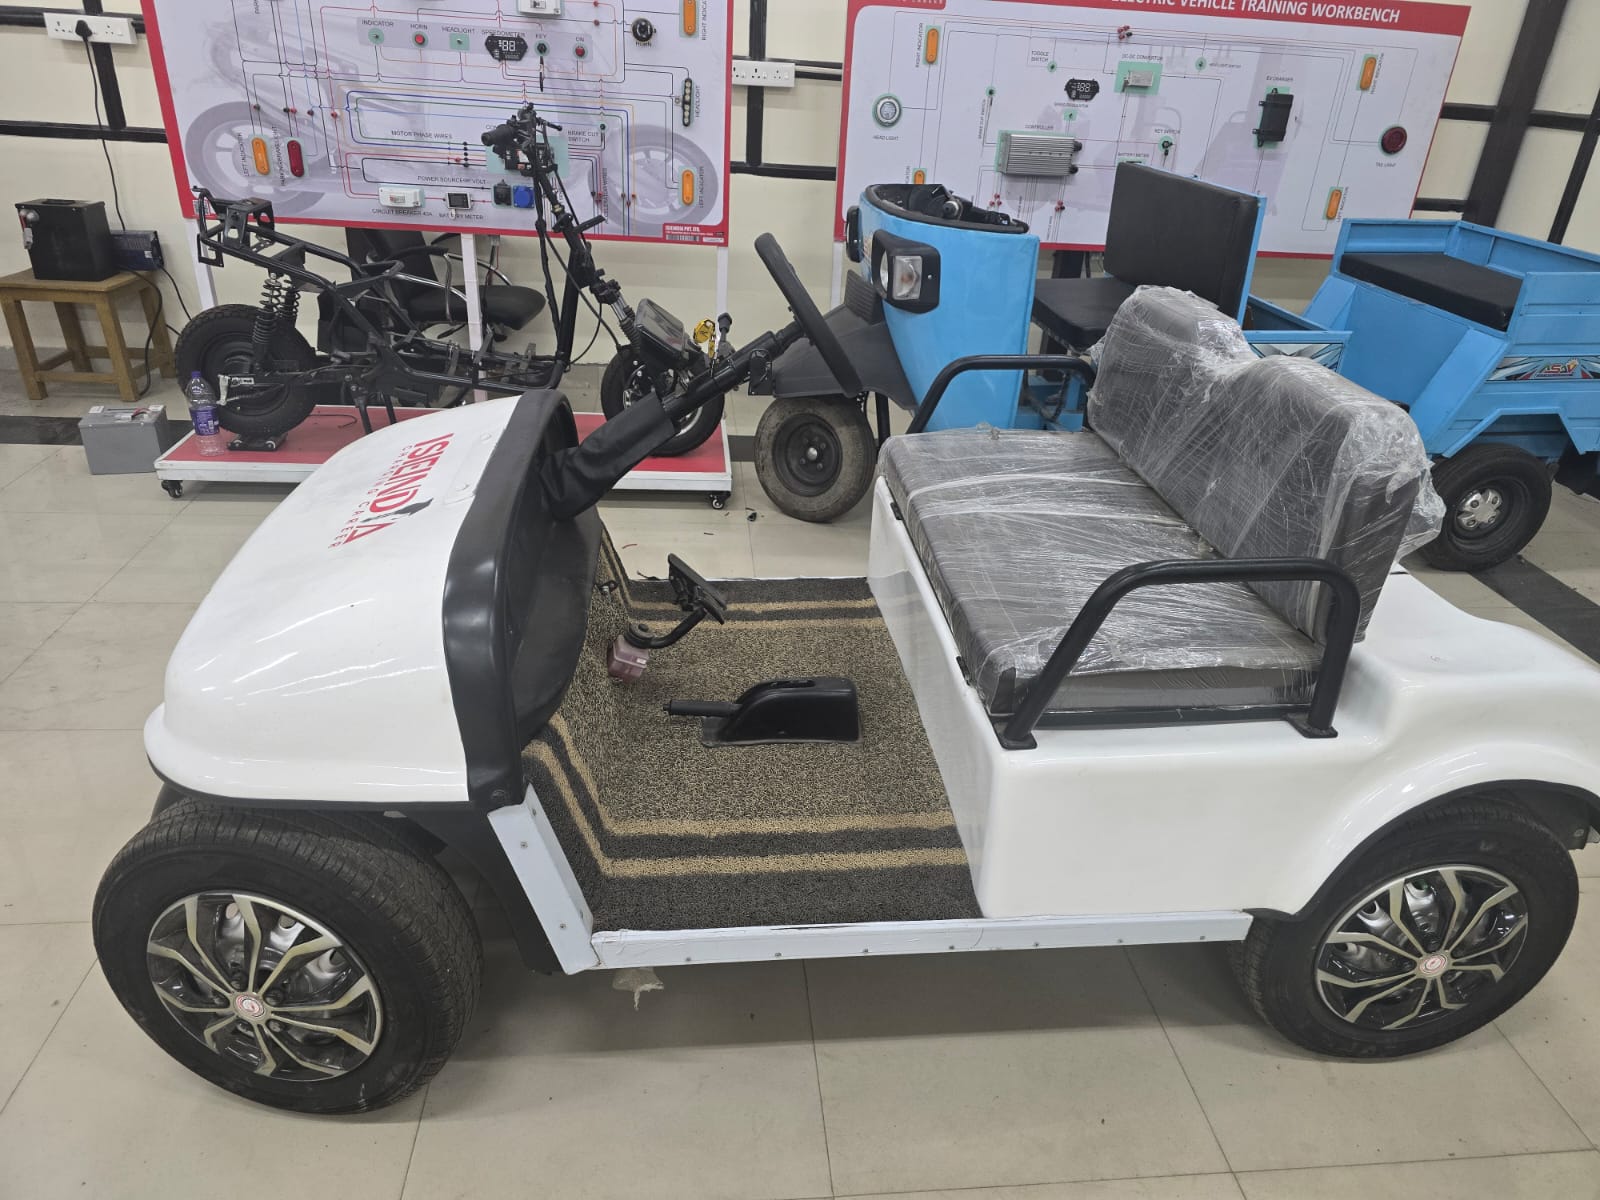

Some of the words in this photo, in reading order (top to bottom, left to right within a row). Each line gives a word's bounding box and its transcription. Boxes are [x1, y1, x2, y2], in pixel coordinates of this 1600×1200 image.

[1181, 0, 1235, 10] VEHICLE
[1241, 0, 1307, 16] TRAINING
[1311, 4, 1400, 24] WORKBENCH
[361, 19, 394, 28] INDICATOR
[441, 26, 475, 34] HEADLIGHT
